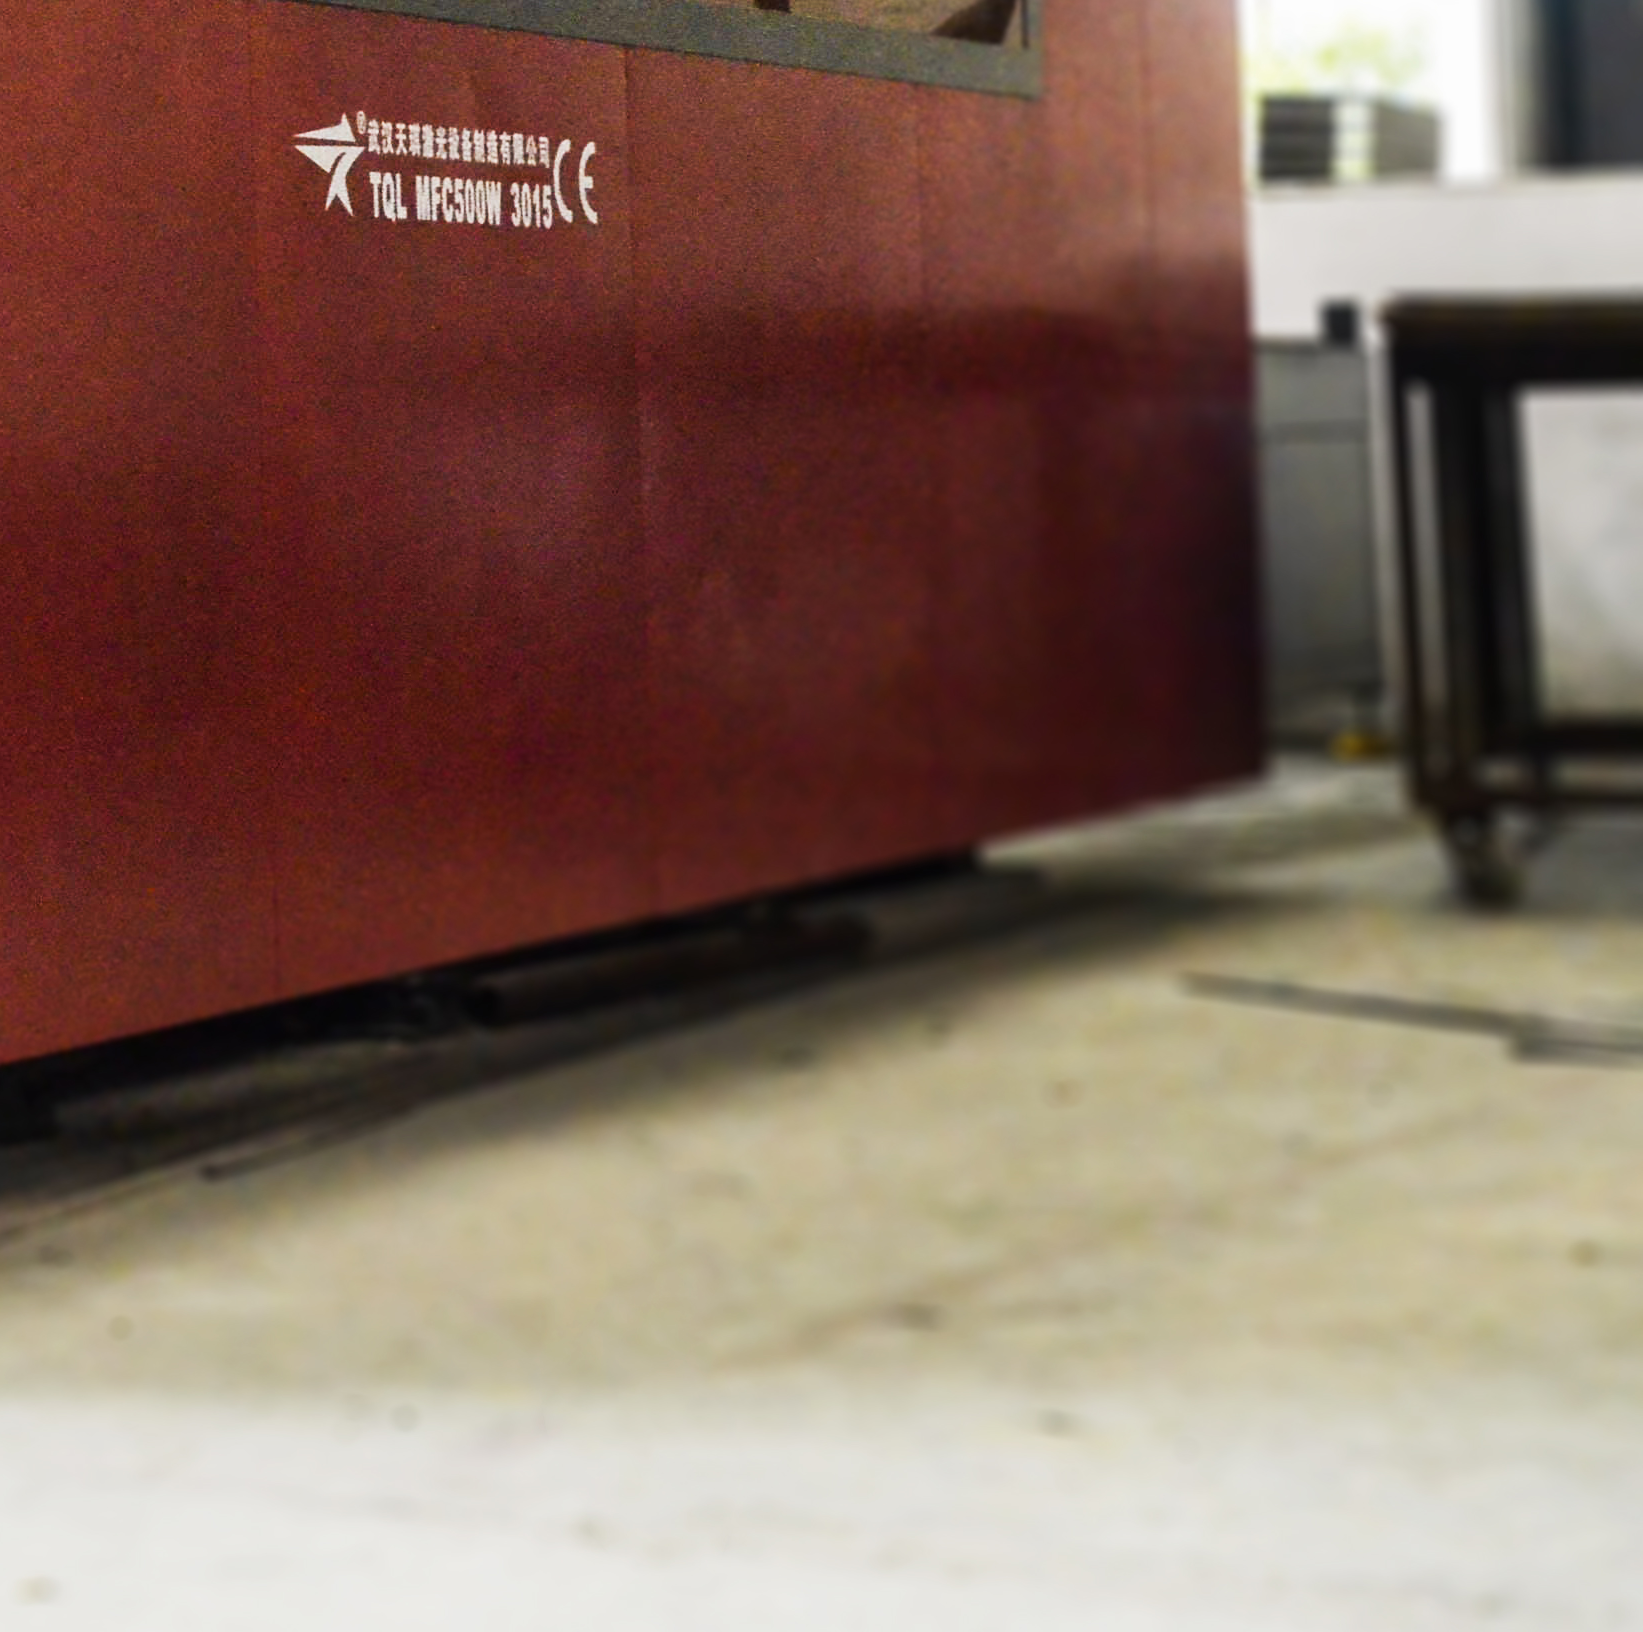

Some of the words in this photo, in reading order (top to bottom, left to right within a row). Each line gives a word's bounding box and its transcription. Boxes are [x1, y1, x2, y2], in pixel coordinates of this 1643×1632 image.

[369, 171, 408, 223] TQL
[415, 174, 502, 226] MFC500W
[510, 181, 553, 229] 3015
